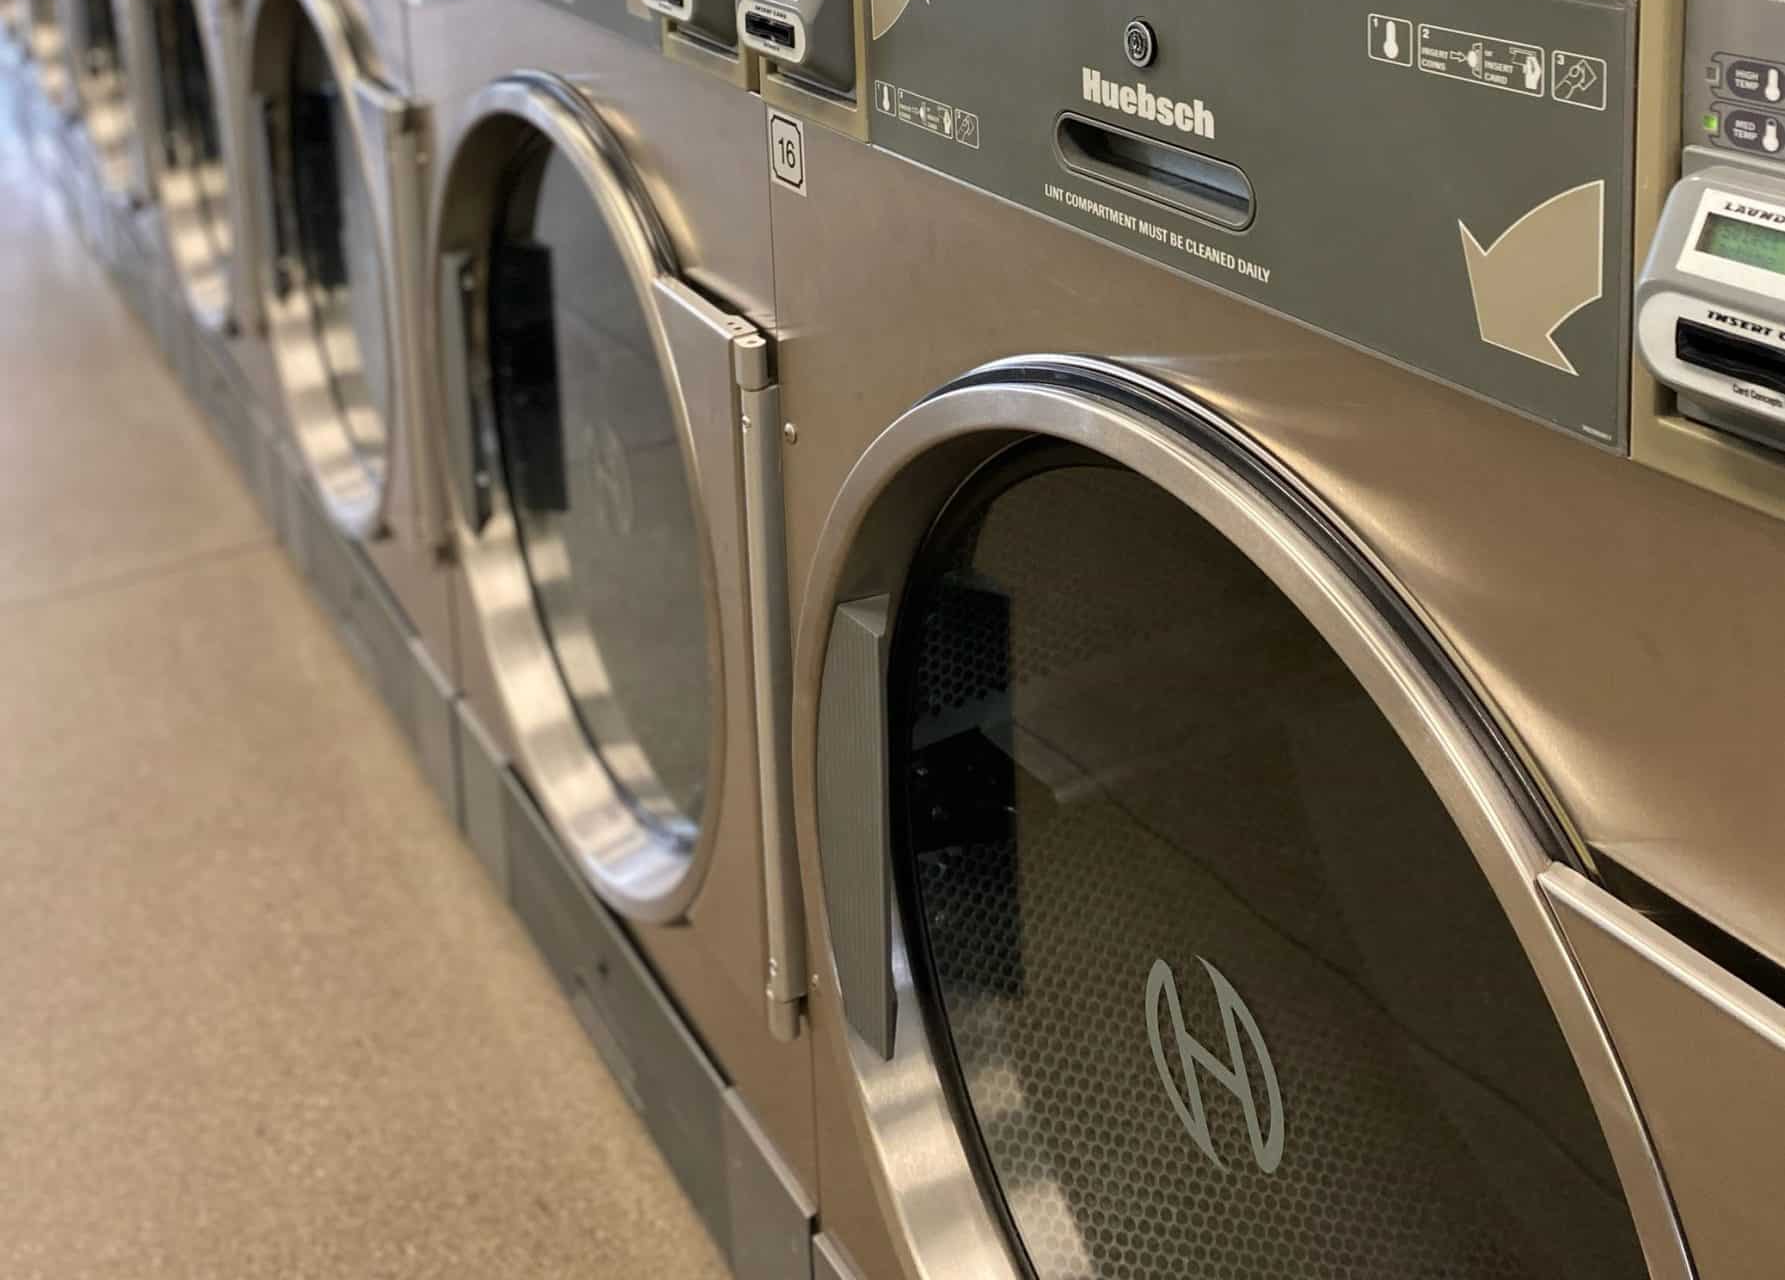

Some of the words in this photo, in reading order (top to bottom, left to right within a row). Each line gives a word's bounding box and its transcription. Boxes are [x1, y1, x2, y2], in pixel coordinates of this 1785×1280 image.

[1422, 27, 1430, 39] 2
[1735, 69, 1759, 81] HIGH
[1082, 66, 1215, 140] Huebsch
[778, 136, 796, 169] 16
[1044, 183, 1064, 201] LINT
[1065, 191, 1137, 232] COMPARTMENT
[1138, 220, 1168, 243] MUST
[1169, 232, 1184, 250] BE
[1185, 238, 1235, 270] CLEANED
[1237, 257, 1271, 283] DAILY
[1707, 310, 1773, 336] INSERT
[1733, 383, 1749, 398] Card
